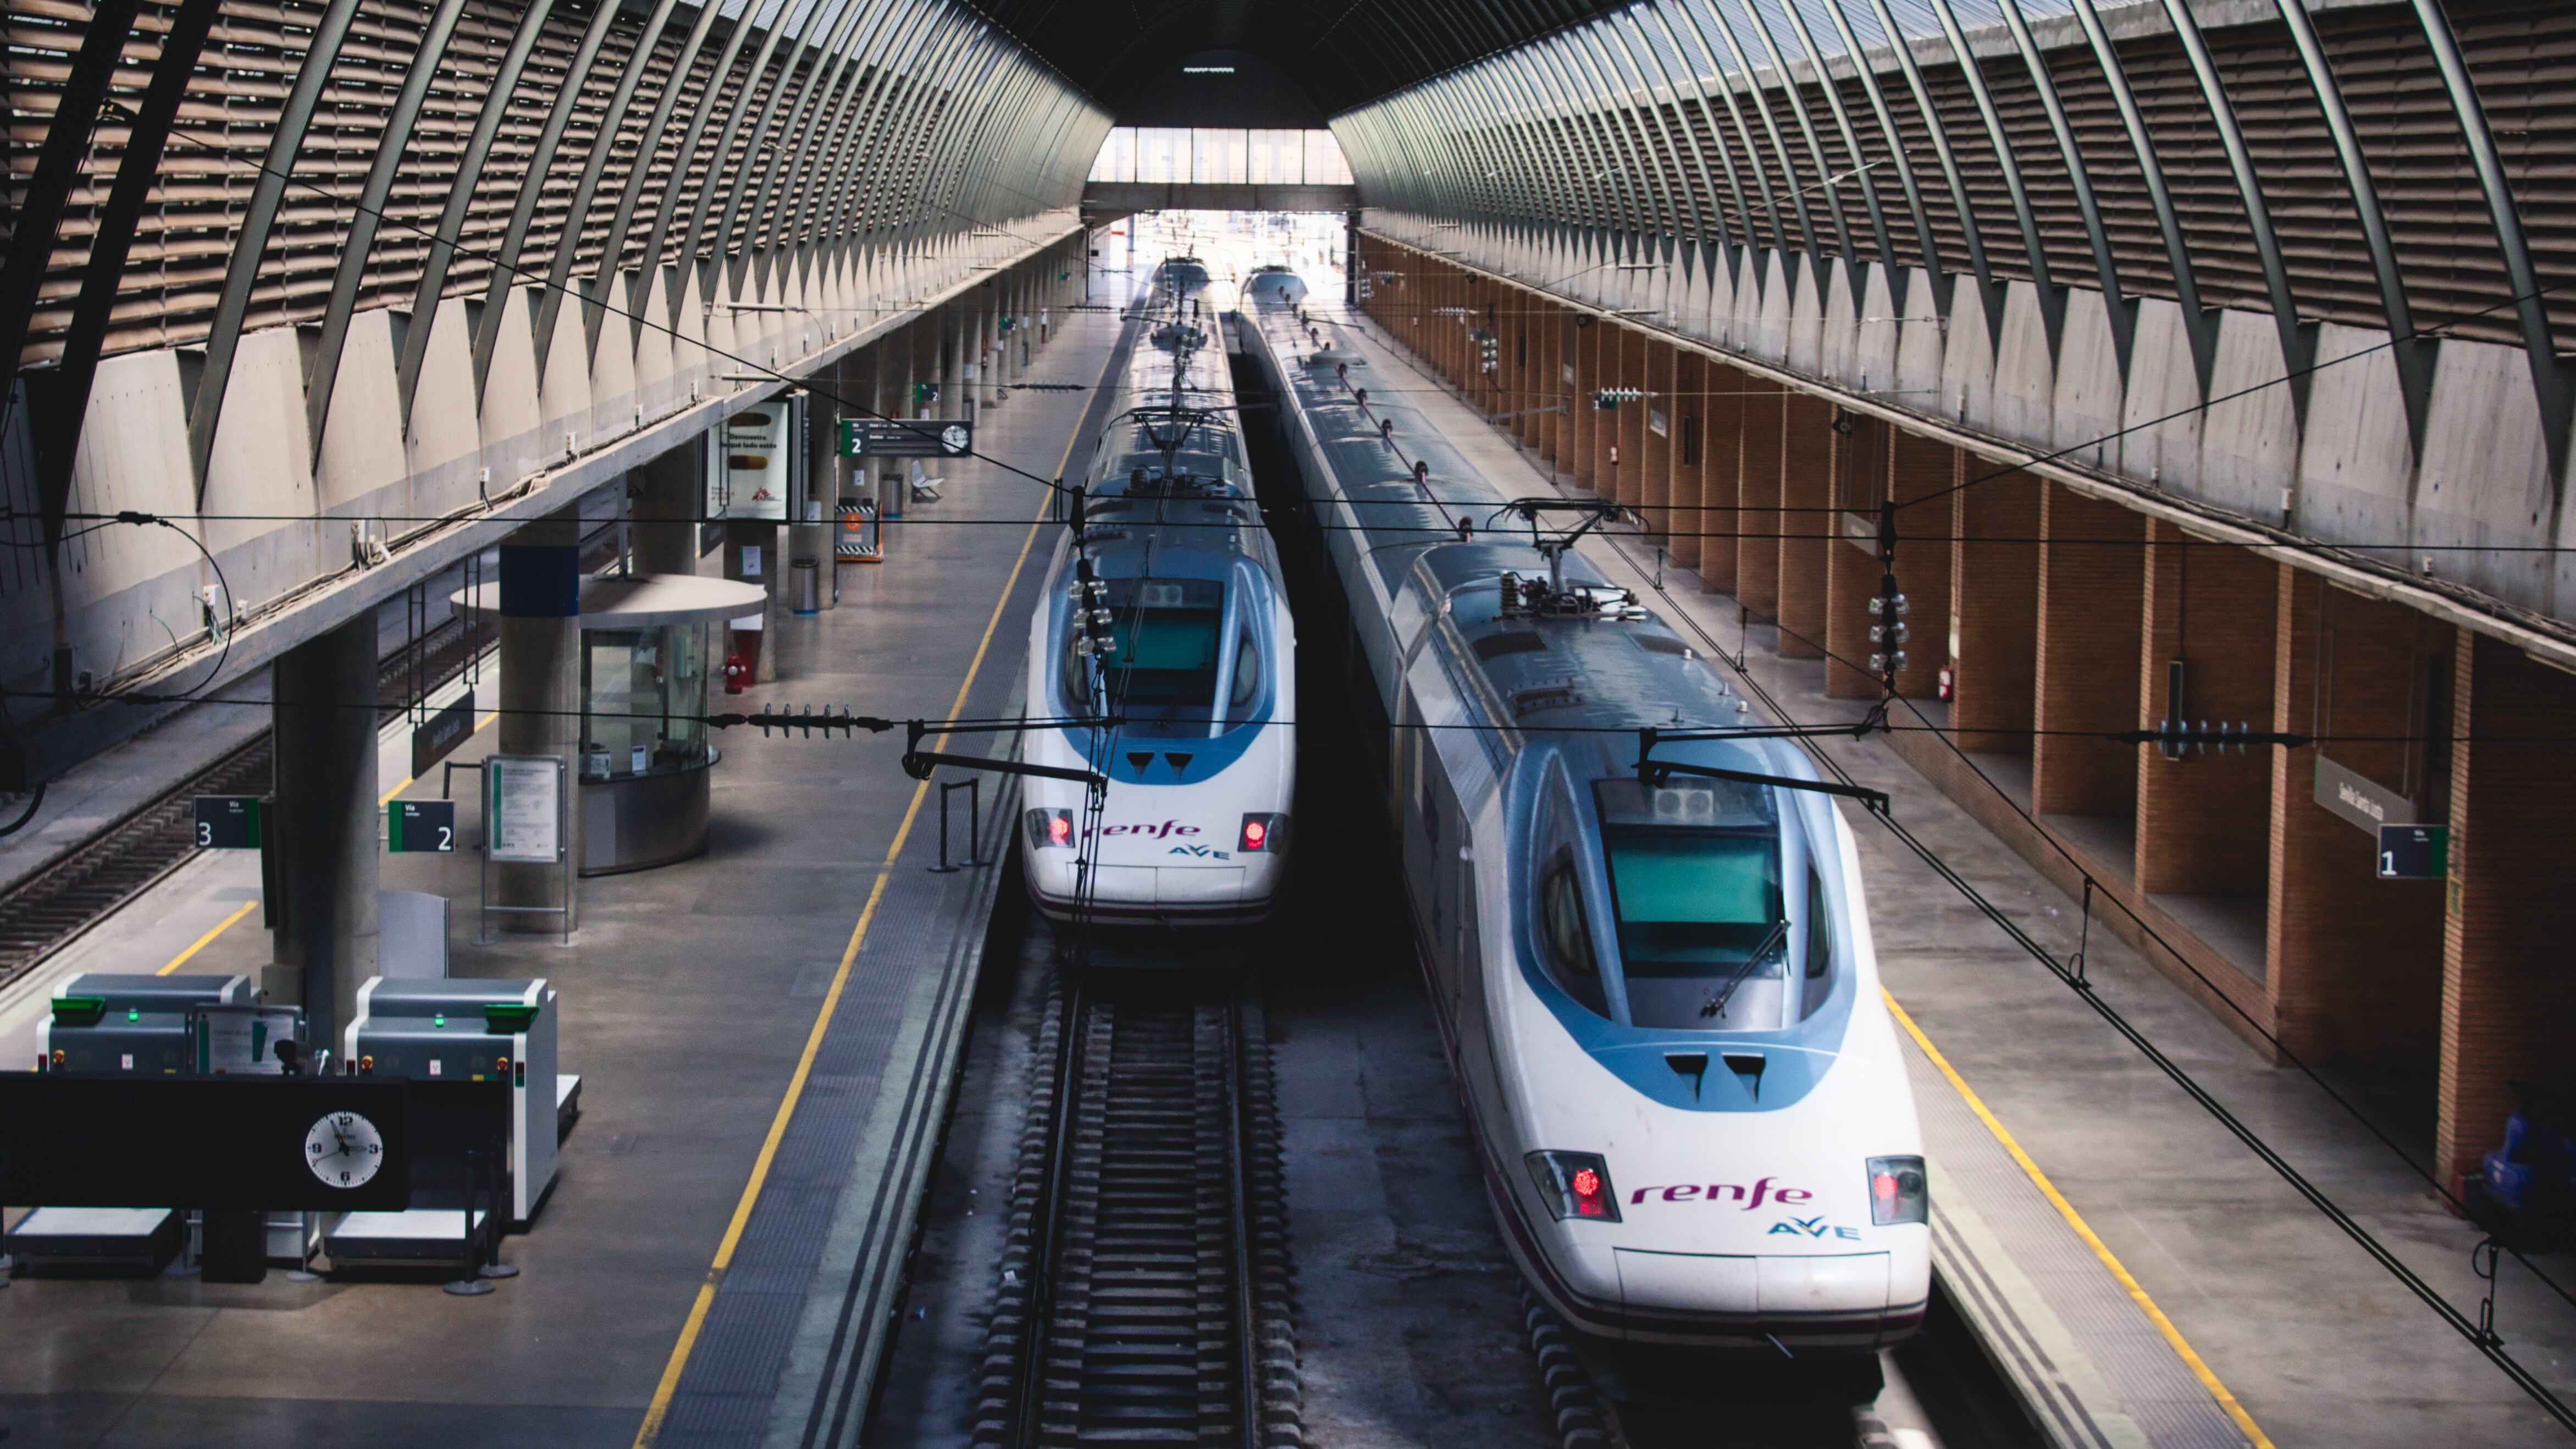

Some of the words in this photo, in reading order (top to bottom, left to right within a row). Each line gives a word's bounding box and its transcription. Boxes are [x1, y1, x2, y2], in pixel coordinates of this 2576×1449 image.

[932, 391, 938, 401] 2
[1594, 400, 1600, 410] 1
[852, 438, 861, 453] 2
[405, 804, 415, 812] Vía
[198, 821, 212, 847] 3
[1084, 819, 1201, 840] renfe
[438, 826, 451, 851] 2
[1168, 843, 1230, 861] AVE
[2381, 850, 2397, 876] 1
[339, 1116, 353, 1126] 12
[312, 1143, 322, 1153] 9
[369, 1144, 378, 1154] 3
[340, 1171, 350, 1181] 6
[1629, 1176, 1813, 1212] renfe
[1767, 1215, 1861, 1240] AVE
